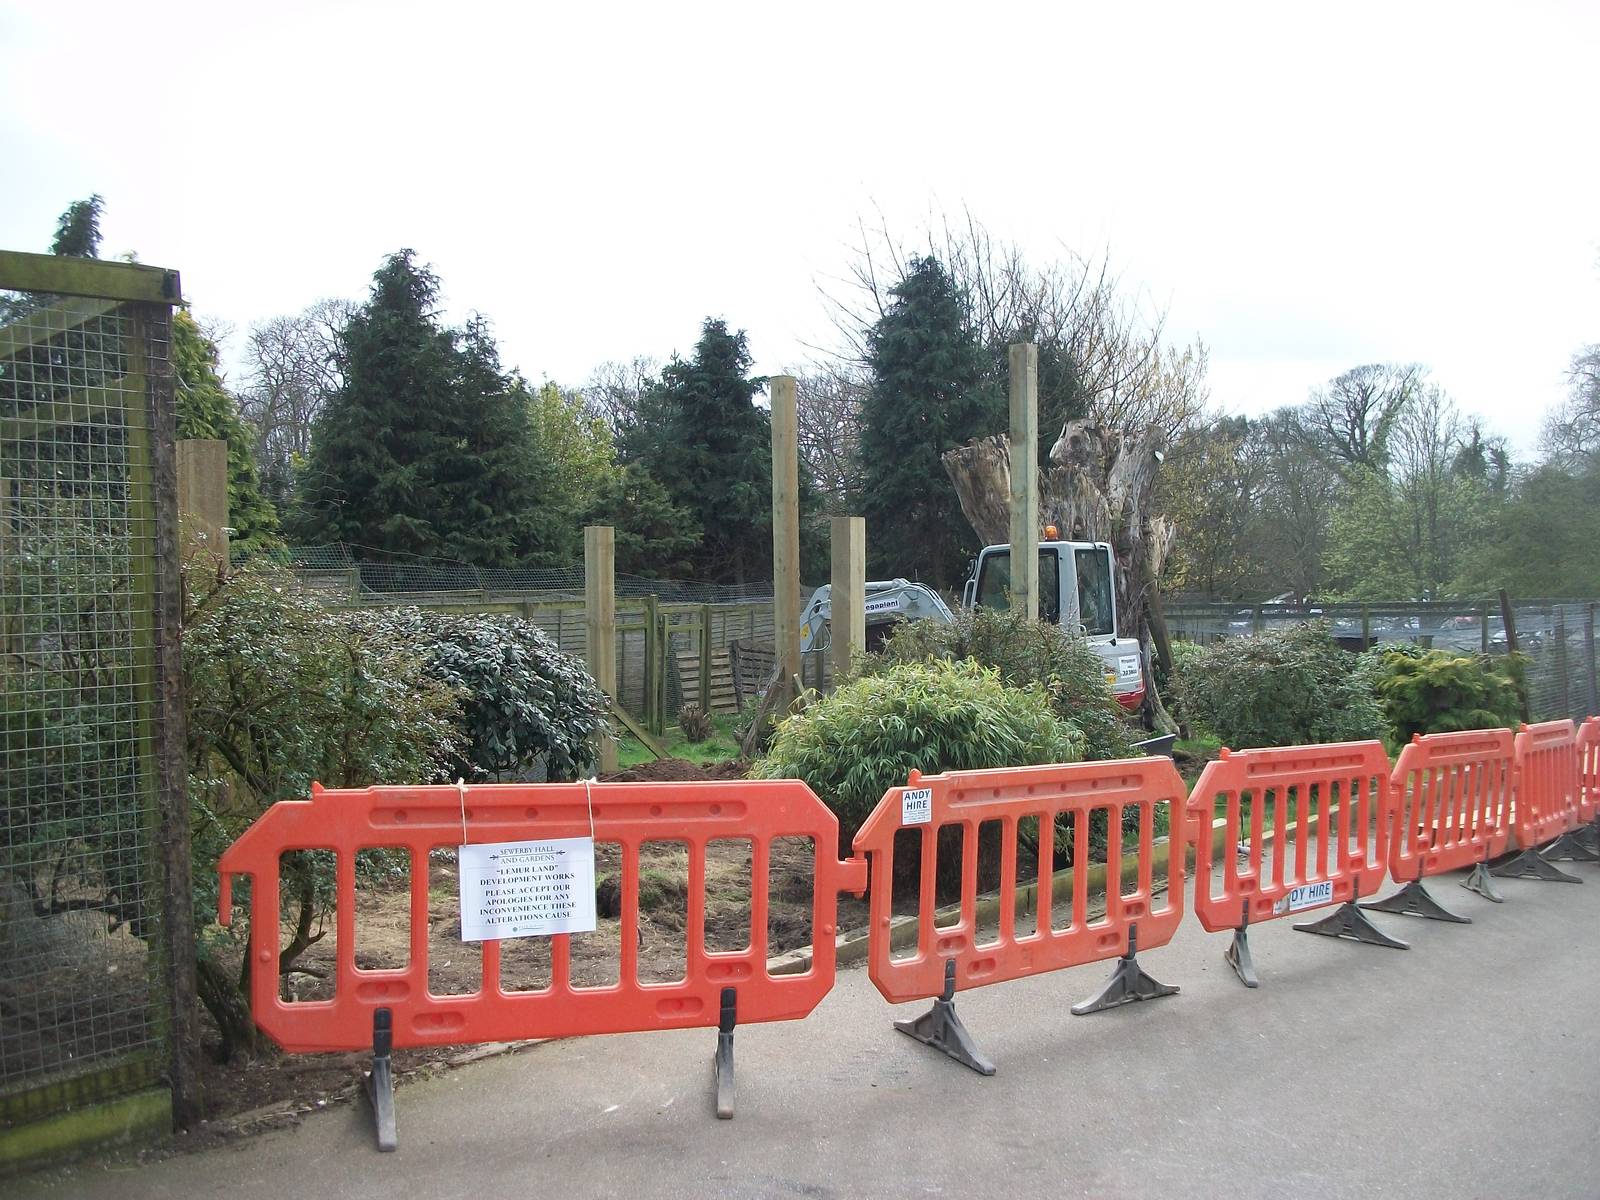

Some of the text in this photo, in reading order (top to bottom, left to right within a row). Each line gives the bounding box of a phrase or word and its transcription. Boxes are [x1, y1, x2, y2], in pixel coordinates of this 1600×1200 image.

[865, 601, 898, 610] egaplant
[904, 790, 930, 800] ANDY
[906, 800, 928, 810] HIRE
[501, 854, 555, 864] AND GARDENS
[480, 873, 575, 886] DEVELOPMENT WORKS
[486, 884, 570, 897] PLEASE ACCEPT OUR
[1309, 883, 1330, 898] HIRE
[486, 896, 532, 906] APOLOGIES
[480, 906, 548, 916] INCONVENIENCE
[486, 911, 572, 924] ALTERATIONS CAUSE
